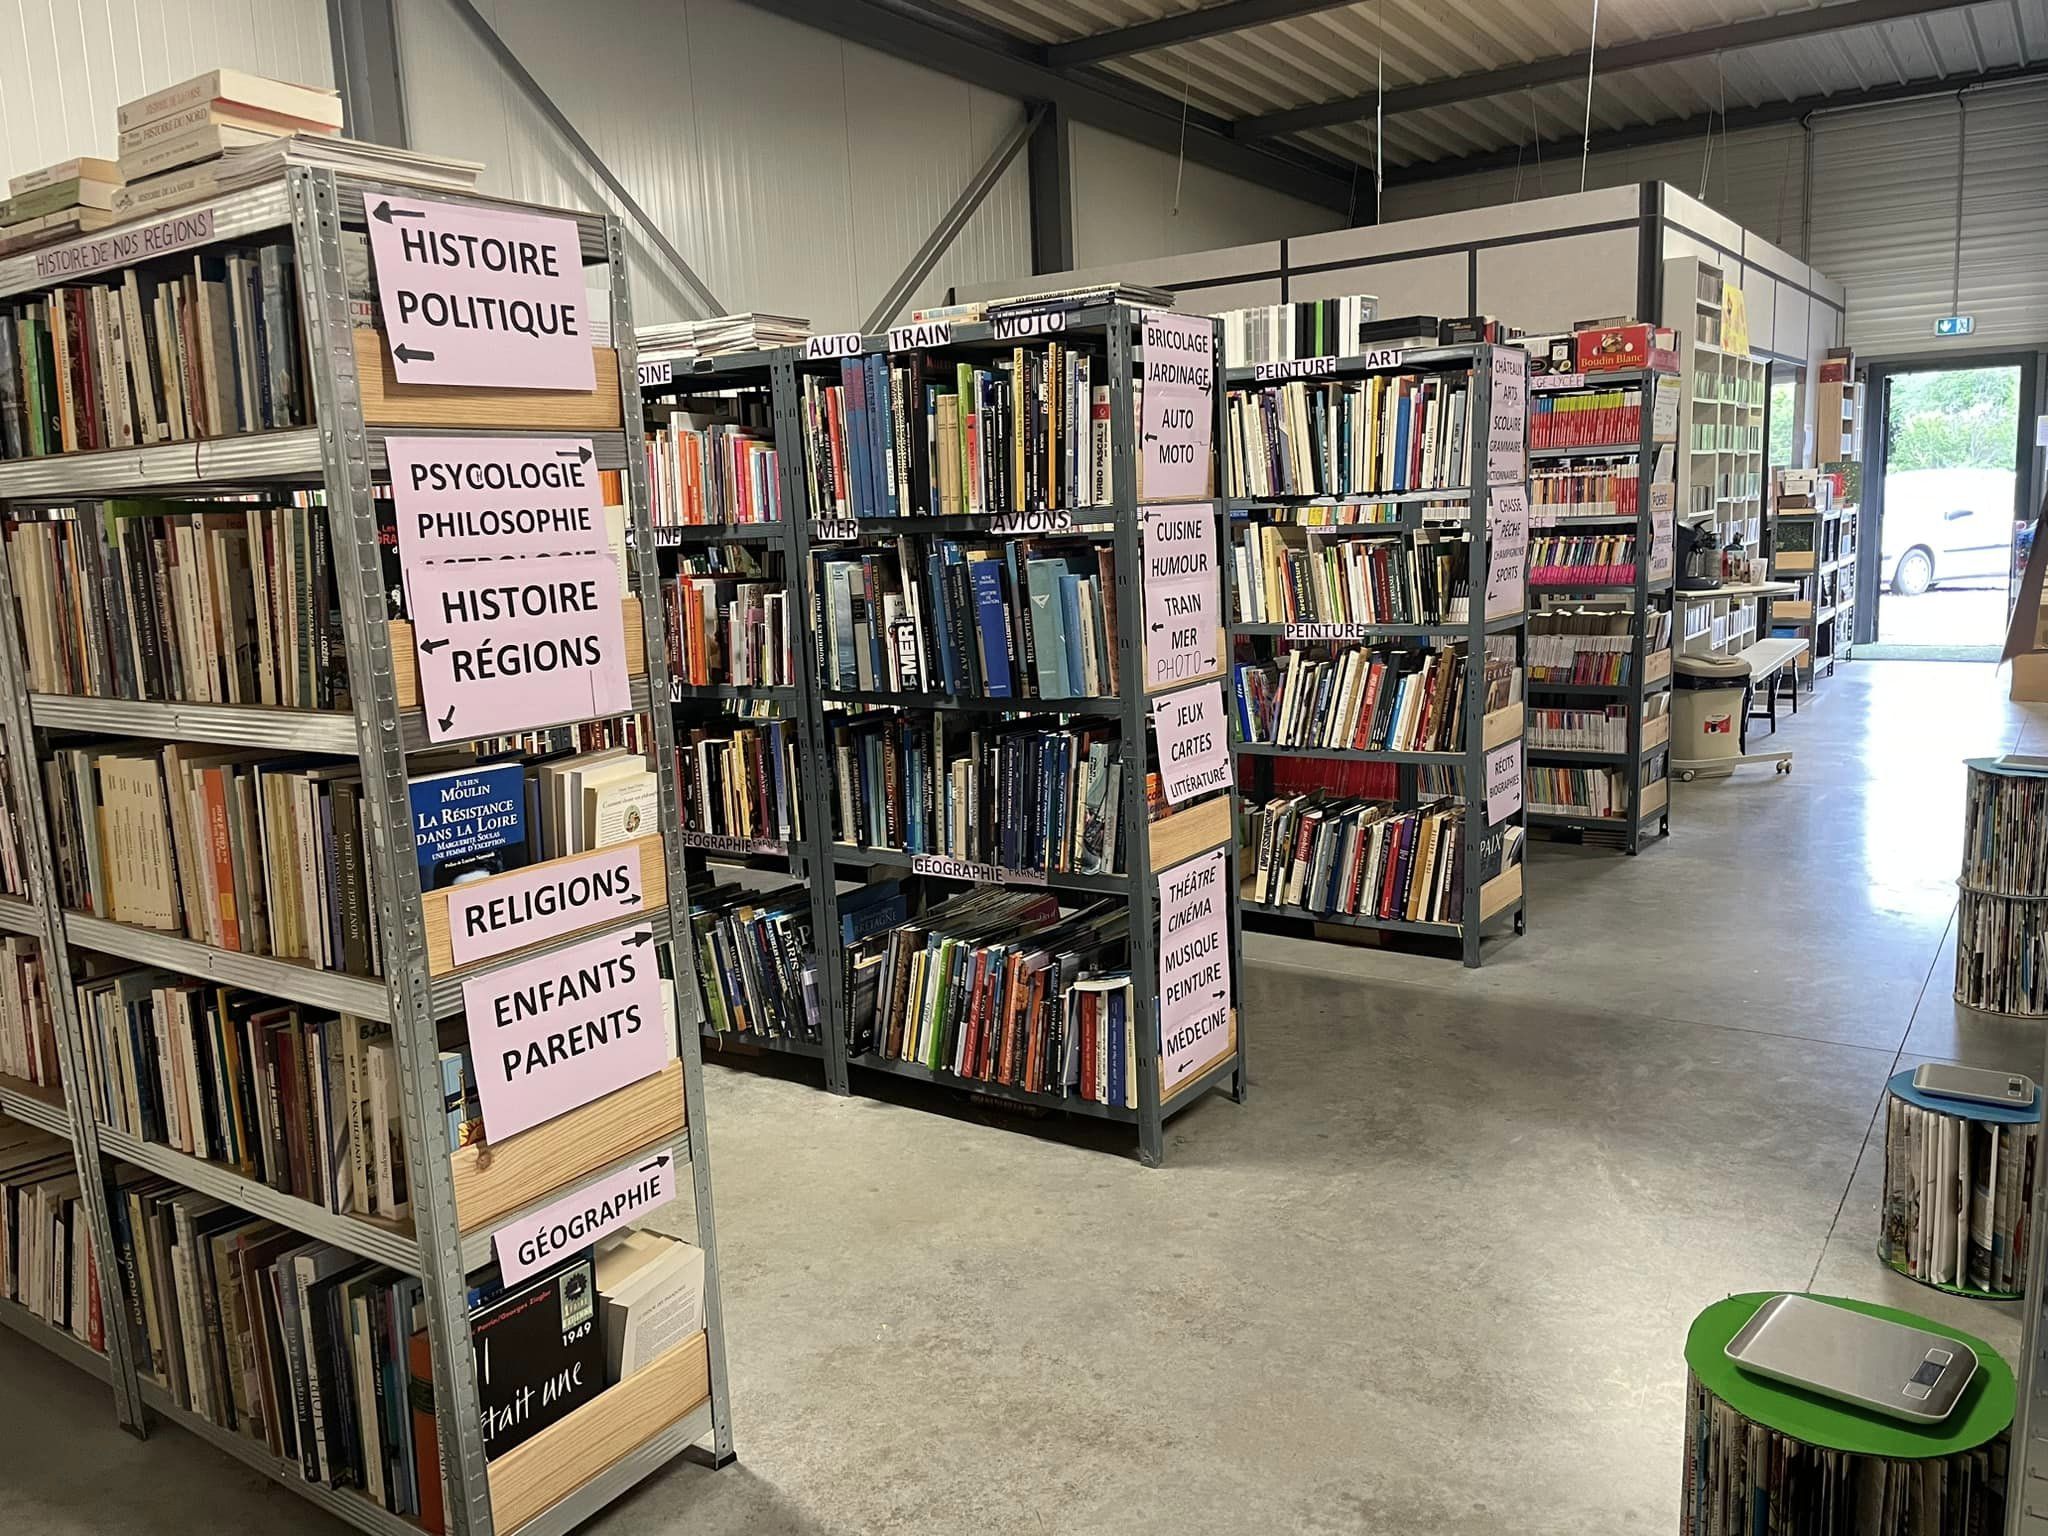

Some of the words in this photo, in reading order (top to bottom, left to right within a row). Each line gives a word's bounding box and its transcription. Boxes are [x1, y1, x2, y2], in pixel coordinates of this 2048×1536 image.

[36, 245, 90, 276] HISTOIRE
[91, 242, 109, 265] DE
[113, 234, 138, 257] NOS
[144, 213, 207, 250] REGIONS
[401, 227, 559, 277] HISTOIRE
[397, 290, 579, 338] POLITIQUE
[996, 312, 1063, 337] MOTO
[810, 336, 861, 357] AUTO
[890, 325, 949, 350] TRAIN
[1148, 328, 1208, 354] BRICOLAGE
[1255, 358, 1335, 380] PEINTURE
[1367, 350, 1402, 367] ART
[1581, 357, 1614, 368] Boudin
[1616, 352, 1643, 363] Blanc
[1149, 362, 1209, 386] JARDINAGE
[1503, 385, 1518, 401] ARTS
[1162, 409, 1193, 429] AUTO
[1493, 416, 1521, 431] SCOLAIRE
[1096, 432, 1104, 467] PASCAL
[1159, 444, 1194, 464] MOTO
[1489, 440, 1521, 453] GRAMMAIRE
[1096, 469, 1104, 501] TURBO
[1500, 498, 1522, 513] CHASSE
[417, 508, 591, 538] PHILOSOPHIE
[818, 520, 857, 539] MER
[993, 510, 1069, 531] AVIONS
[1157, 520, 1202, 541] CUISINE
[1152, 554, 1208, 578] HUMOUR
[1496, 566, 1518, 583] SPORTS
[441, 580, 598, 624] HISTOIRE
[1294, 561, 1307, 616] l'architecture
[1164, 593, 1202, 617] TRAIN
[1171, 628, 1197, 650] MER
[1286, 624, 1364, 638] PEINTURE
[817, 624, 825, 666] COURRIERS
[897, 624, 917, 675] MER
[452, 636, 601, 682] RÉGIONS
[1157, 651, 1201, 681] PHOTO
[1177, 702, 1204, 727] JEUX
[1171, 733, 1212, 761] CARTES
[440, 785, 491, 803] MOULIN
[1170, 767, 1226, 798] LITTÉRATURE
[1489, 774, 1519, 798] BIOGRAPHIES
[441, 800, 514, 825] RÉSISTANCE
[416, 828, 452, 846] DANS
[457, 824, 473, 837] LA
[477, 814, 518, 833] LOIRE
[343, 832, 353, 870] QUERCY
[1479, 832, 1503, 858] PAIX
[914, 855, 1004, 882] GÉOGRAPHIE
[1169, 865, 1217, 903] THÉÂTRE
[347, 887, 358, 940] MONTAIGU
[465, 865, 630, 937] RELIGIONS
[1168, 898, 1212, 933] CINÉMA
[782, 929, 800, 971] PARIS
[1165, 932, 1219, 974] MUSIQUE
[494, 954, 636, 1028] ENFANTS
[1166, 962, 1221, 1006] PEINTURE
[502, 1005, 642, 1082] PARENTS
[1166, 1007, 1227, 1057] MÉDECINE
[518, 1175, 662, 1266] GÉOGRAPHIE
[562, 1321, 592, 1347] 1949
[543, 1361, 583, 1407] une
